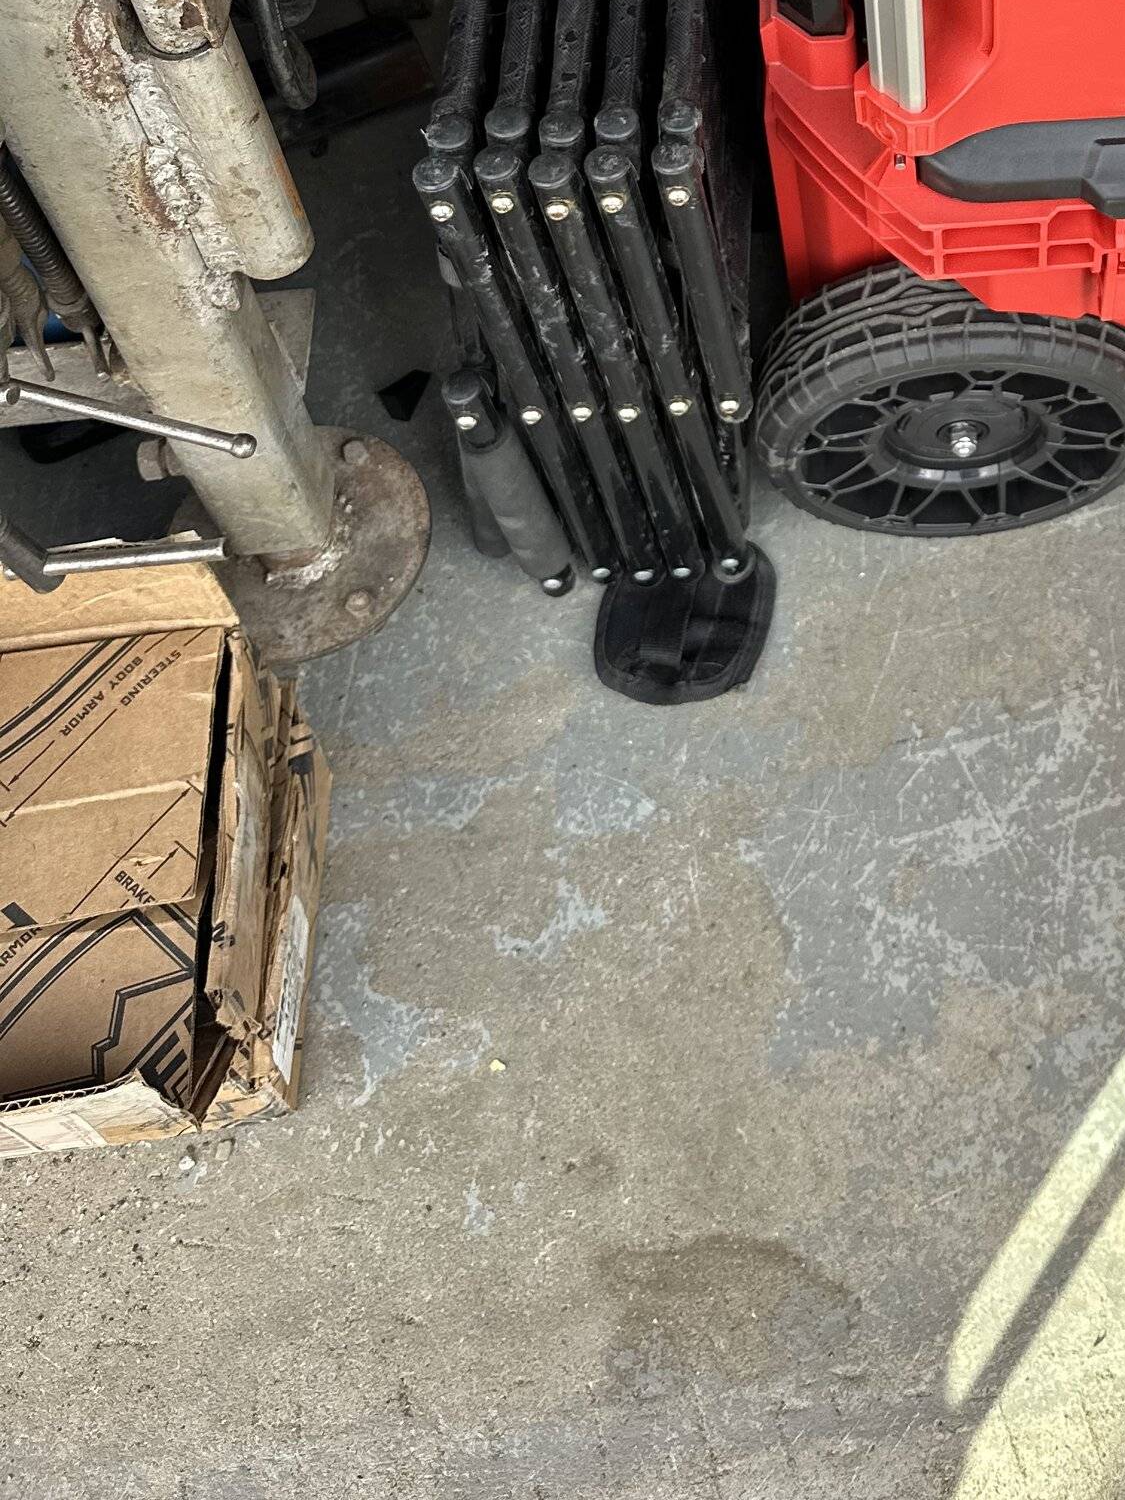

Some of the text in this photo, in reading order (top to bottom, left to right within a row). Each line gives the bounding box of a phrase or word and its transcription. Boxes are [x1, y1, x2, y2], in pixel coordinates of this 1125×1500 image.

[59, 656, 144, 737] BODY ARMOR
[120, 649, 182, 707] STEERING
